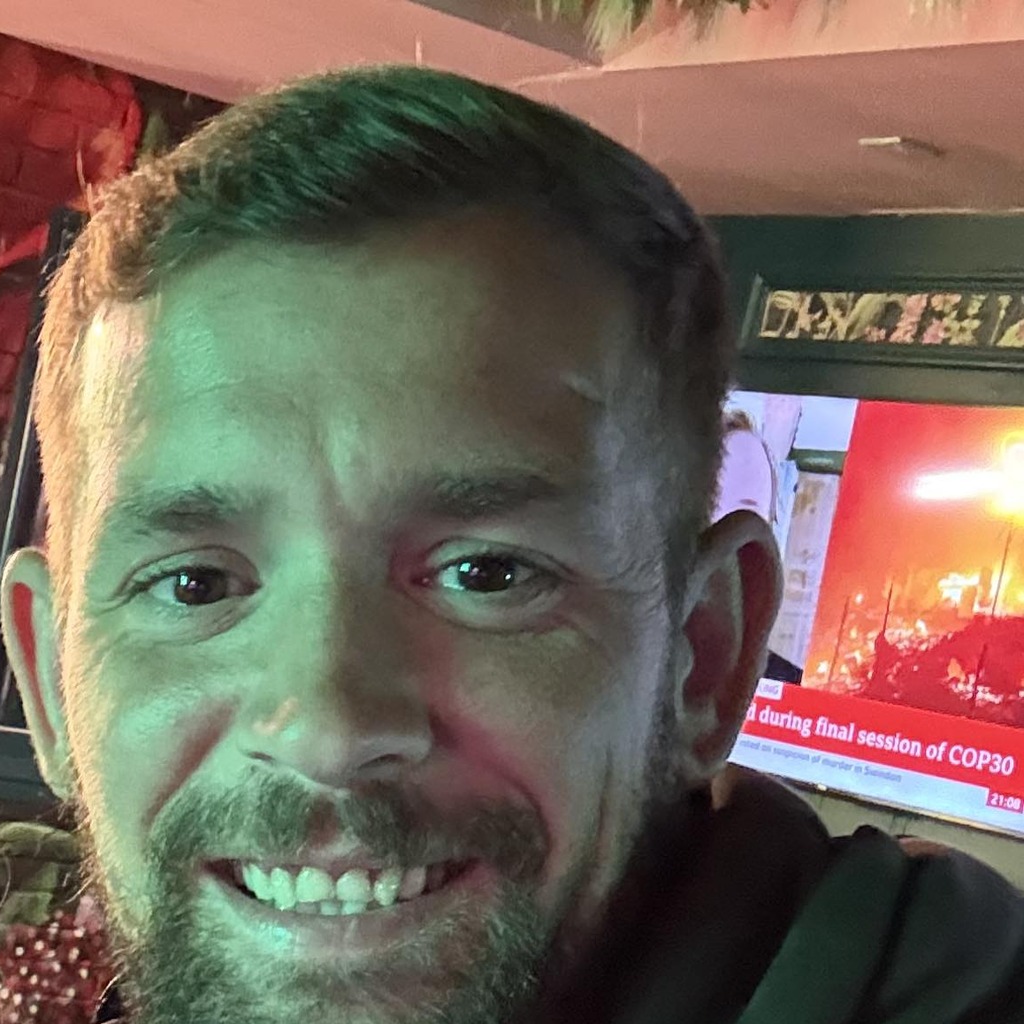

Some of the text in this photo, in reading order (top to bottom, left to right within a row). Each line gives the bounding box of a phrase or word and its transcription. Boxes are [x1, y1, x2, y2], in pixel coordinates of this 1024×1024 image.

[759, 705, 813, 738] during
[815, 716, 855, 743] final
[857, 730, 921, 757] session
[926, 741, 949, 761] of
[949, 745, 1015, 775] COP30
